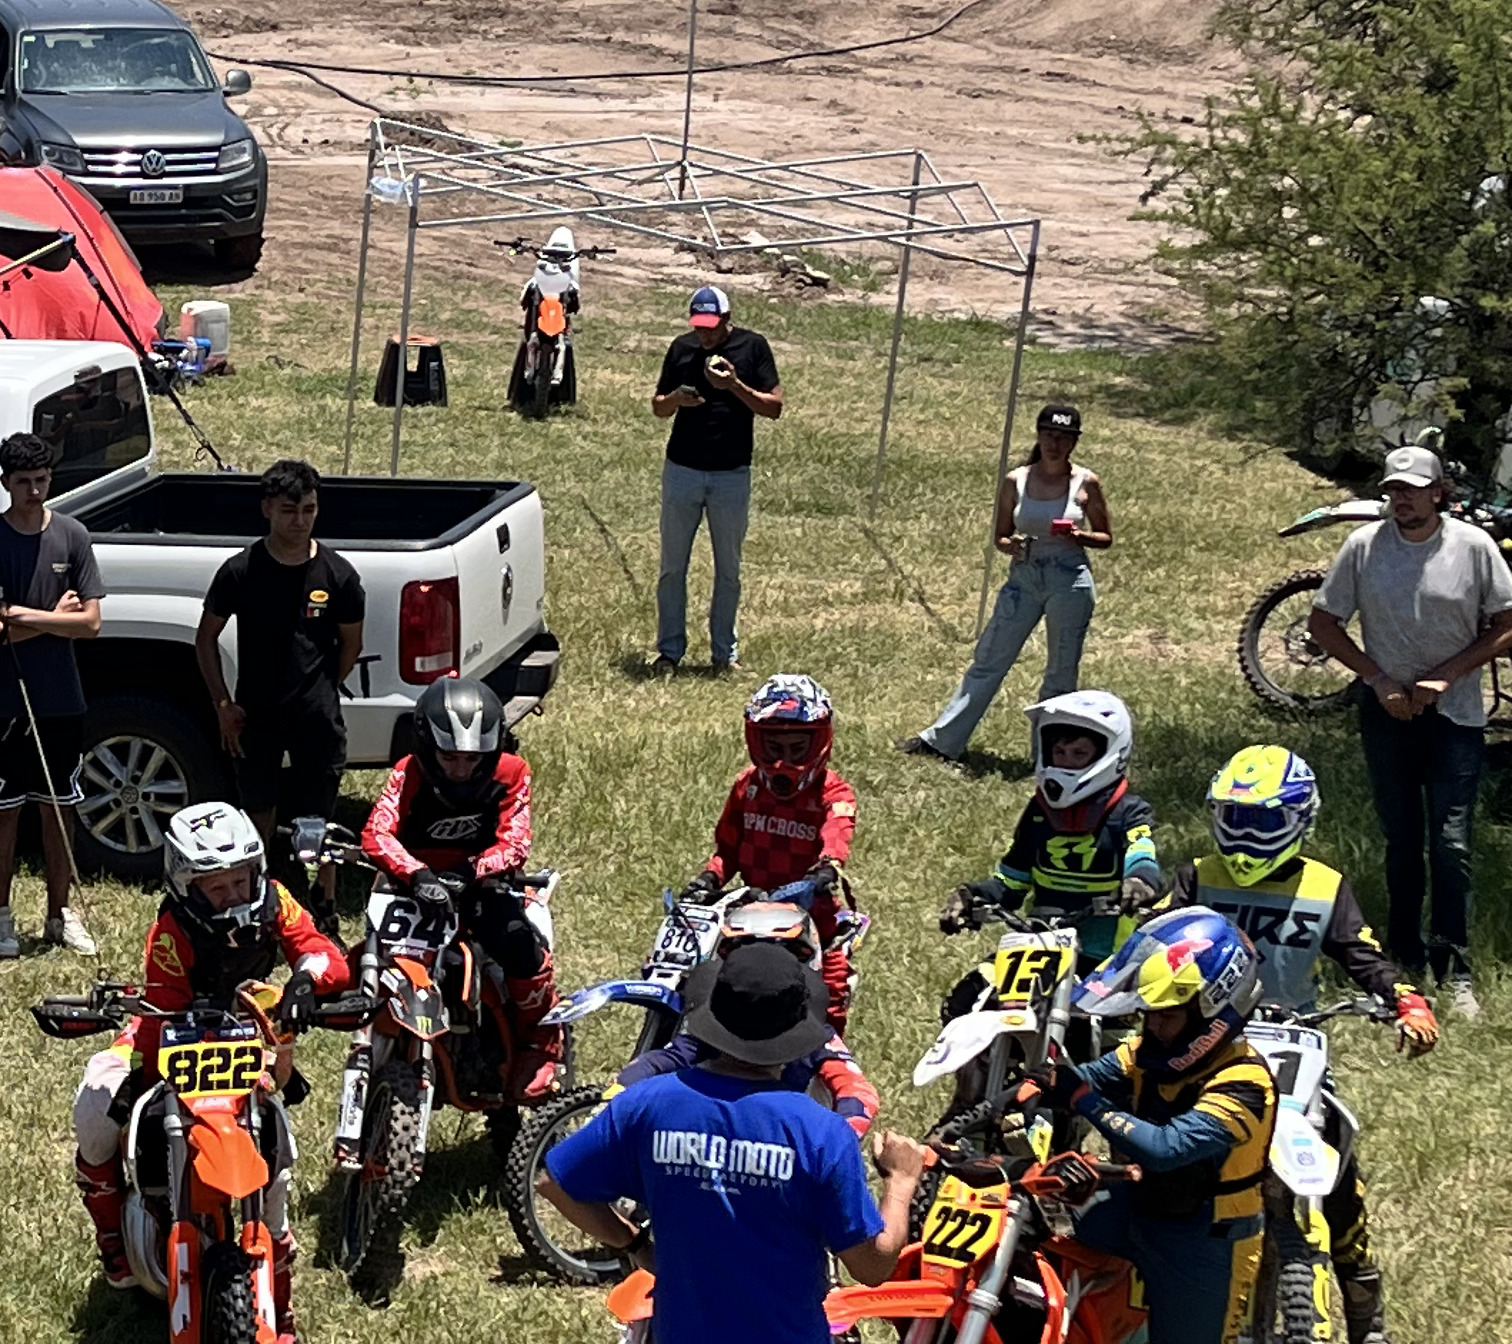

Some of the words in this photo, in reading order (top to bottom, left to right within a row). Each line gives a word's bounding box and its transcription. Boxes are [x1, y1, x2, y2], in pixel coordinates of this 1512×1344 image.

[766, 815, 818, 842] CROSS
[380, 898, 456, 949] 64
[1000, 949, 1063, 995] 13
[167, 1045, 263, 1093] 822
[652, 1129, 727, 1170] WORLD
[727, 1138, 796, 1181] MOTO
[923, 1205, 993, 1263] 222
